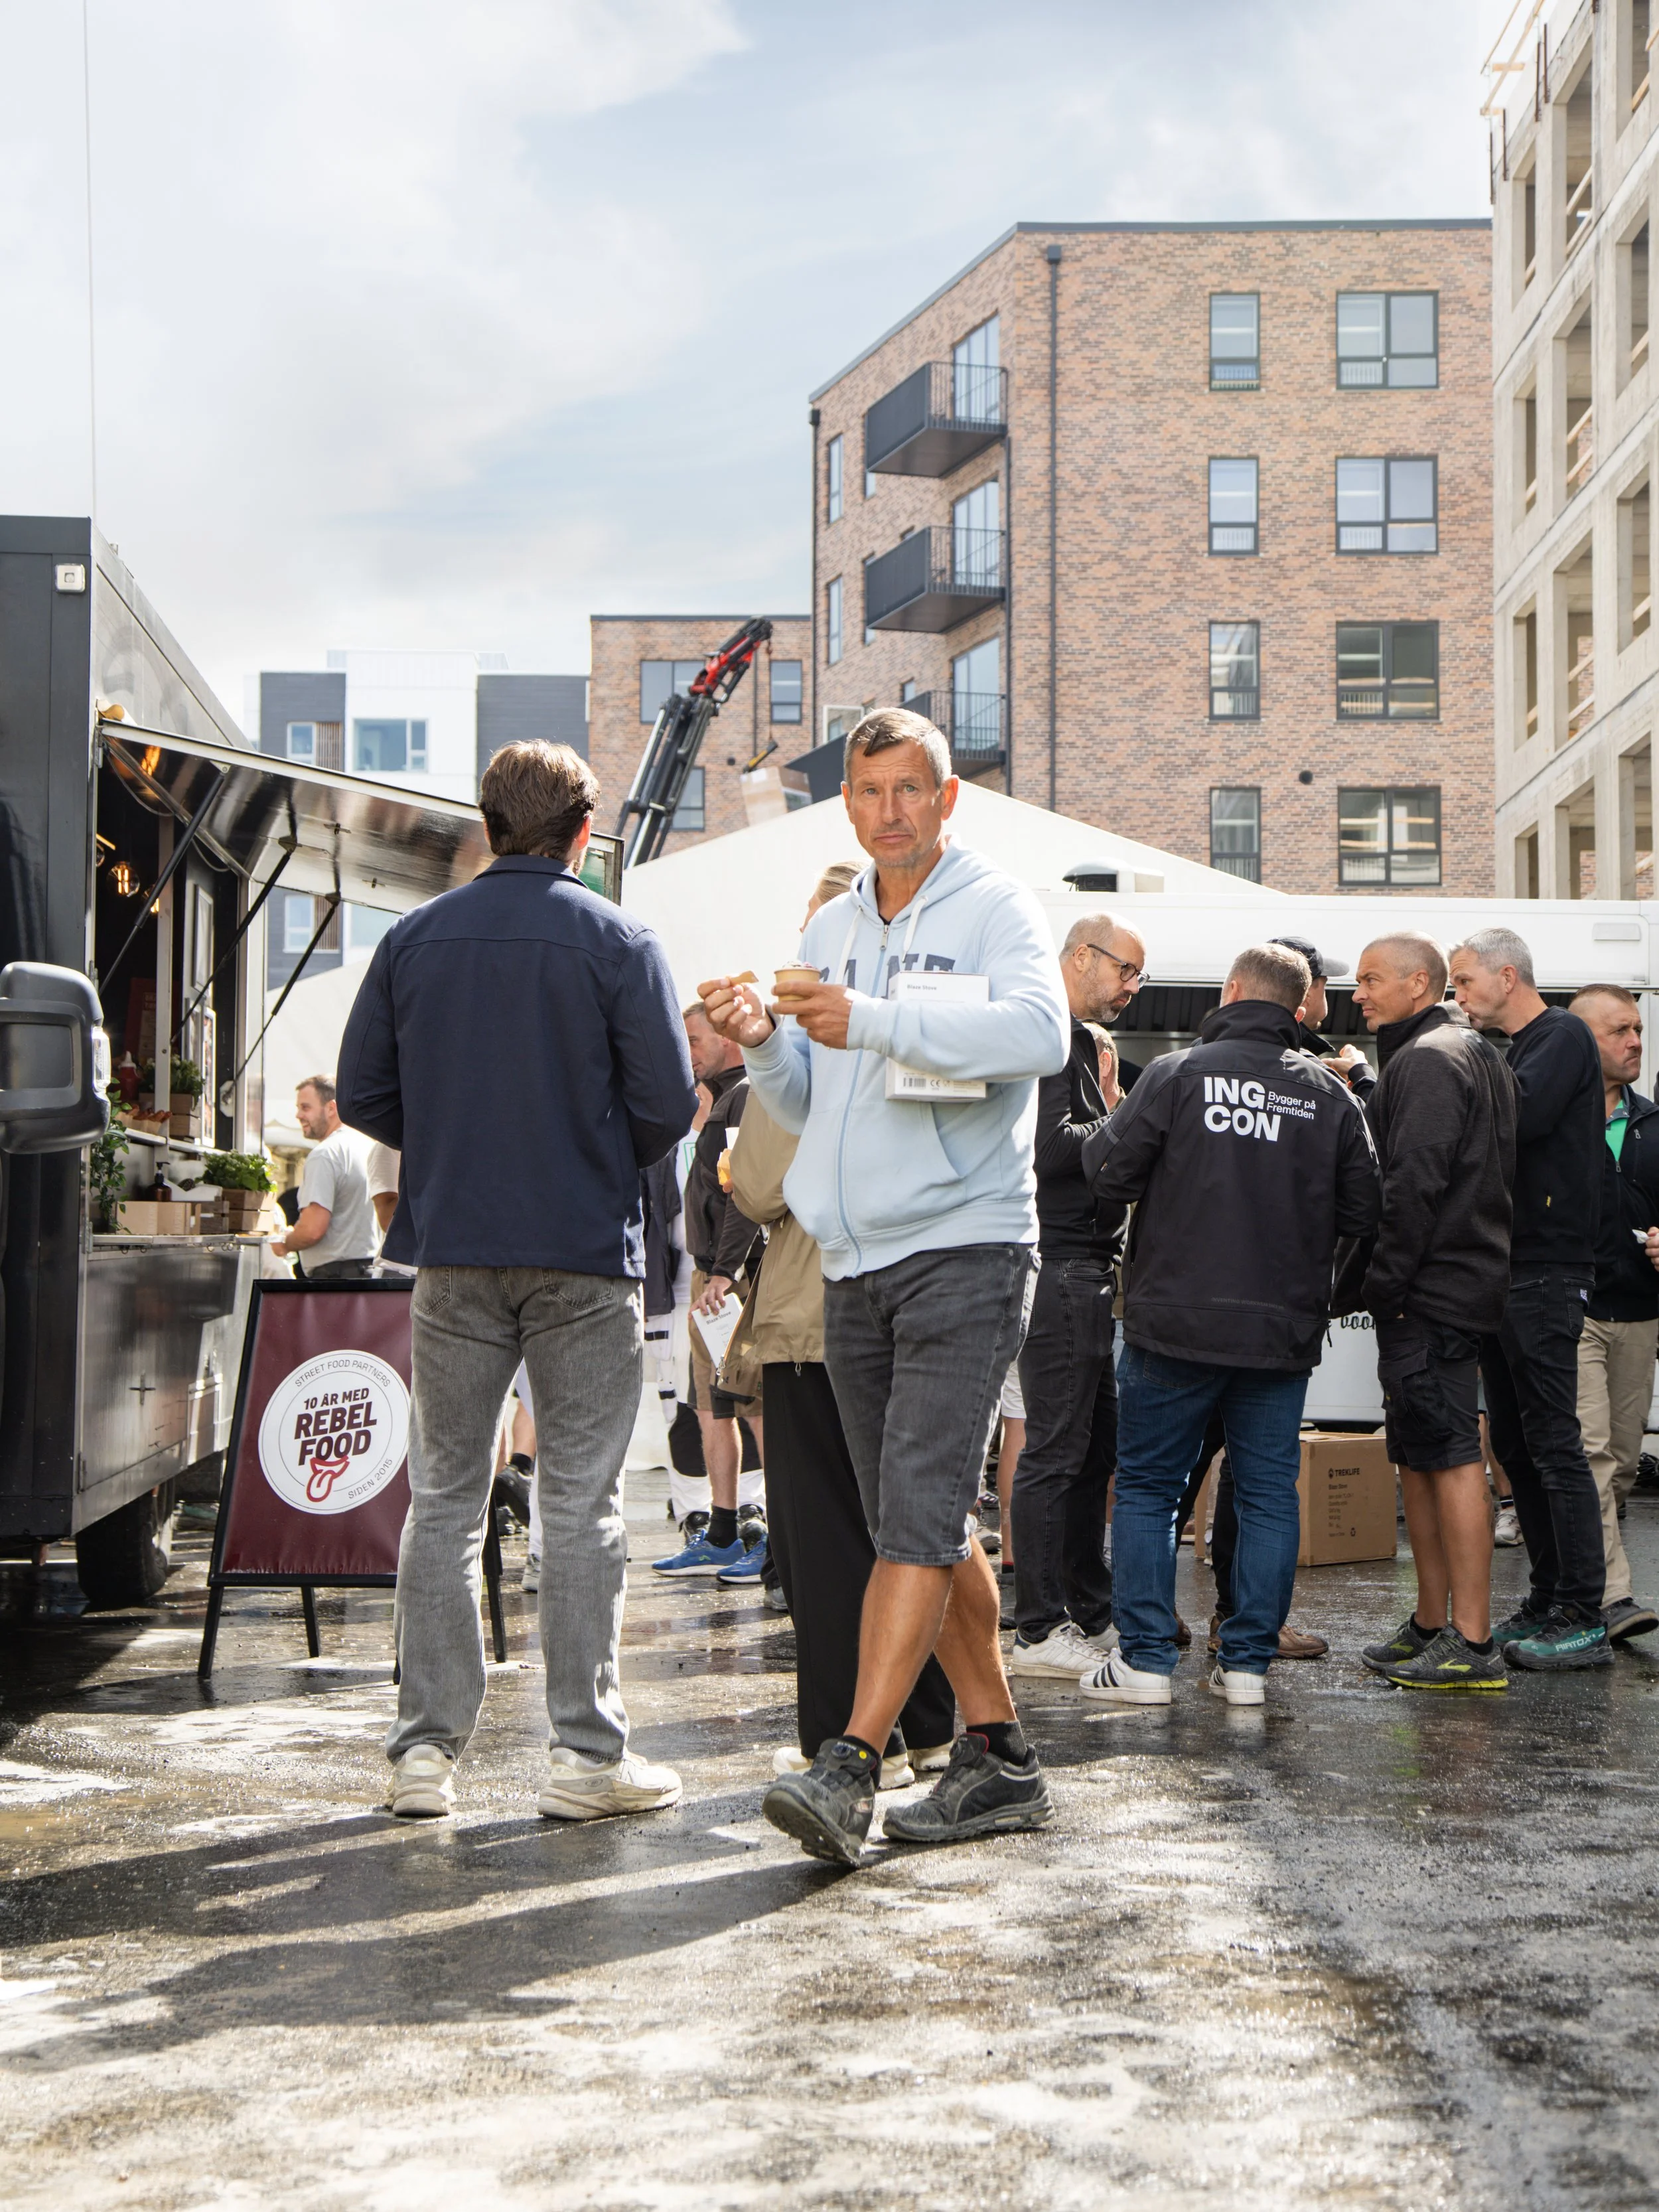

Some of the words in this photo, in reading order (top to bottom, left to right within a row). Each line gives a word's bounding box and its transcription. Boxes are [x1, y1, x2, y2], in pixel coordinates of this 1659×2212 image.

[1204, 1076, 1265, 1110] ING
[1268, 1090, 1303, 1107] Bygger
[1304, 1100, 1317, 1110] på
[1204, 1104, 1281, 1142] CON
[1266, 1102, 1315, 1120] Fremtiden
[295, 1364, 325, 1387] STREET
[328, 1359, 350, 1369] FOOD
[352, 1360, 391, 1387] PARTNERS
[303, 1397, 318, 1410] 10
[321, 1393, 339, 1407] ÅR
[342, 1388, 370, 1403] MED
[294, 1401, 377, 1439] REBEL
[298, 1429, 372, 1466] FOOD
[348, 1479, 375, 1499] SIDEN
[374, 1458, 393, 1481] 2015
[1334, 1467, 1360, 1477] TREKLIFE
[1555, 1635, 1592, 1652] AIRTOX
